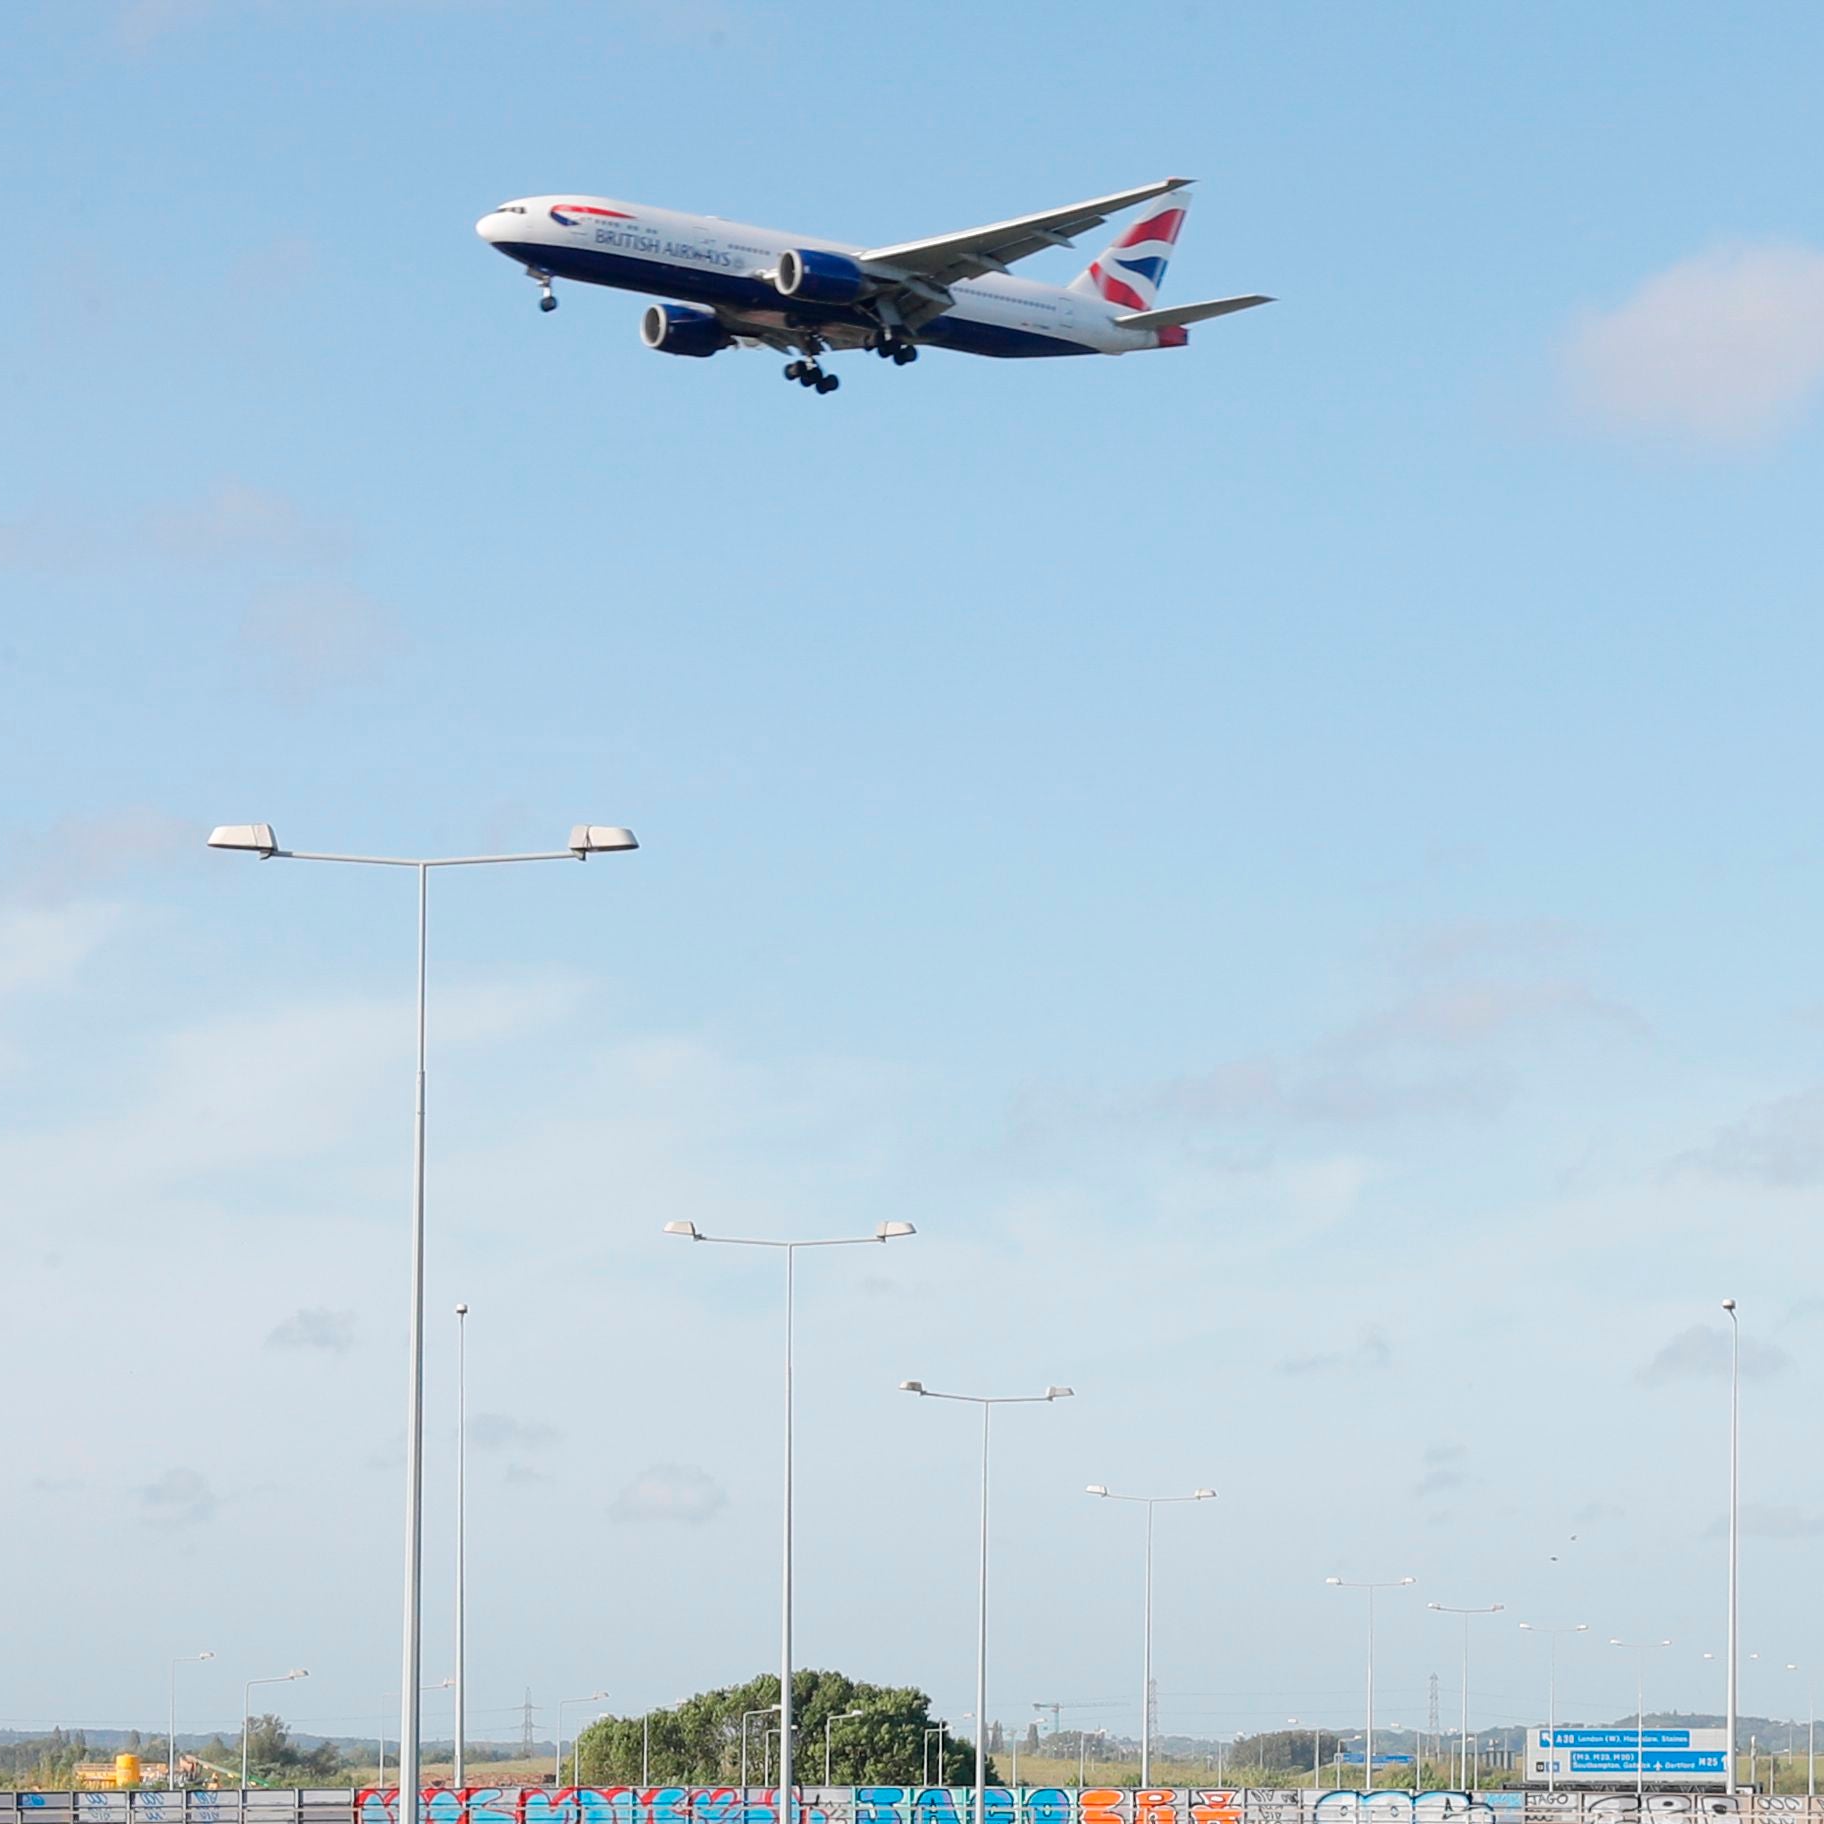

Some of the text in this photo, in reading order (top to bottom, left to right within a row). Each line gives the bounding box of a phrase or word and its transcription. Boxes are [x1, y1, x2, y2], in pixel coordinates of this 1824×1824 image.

[595, 228, 730, 268] BRITISH AIRWAYS
[1556, 1734, 1574, 1744] A30
[1698, 1757, 1718, 1767] M25
